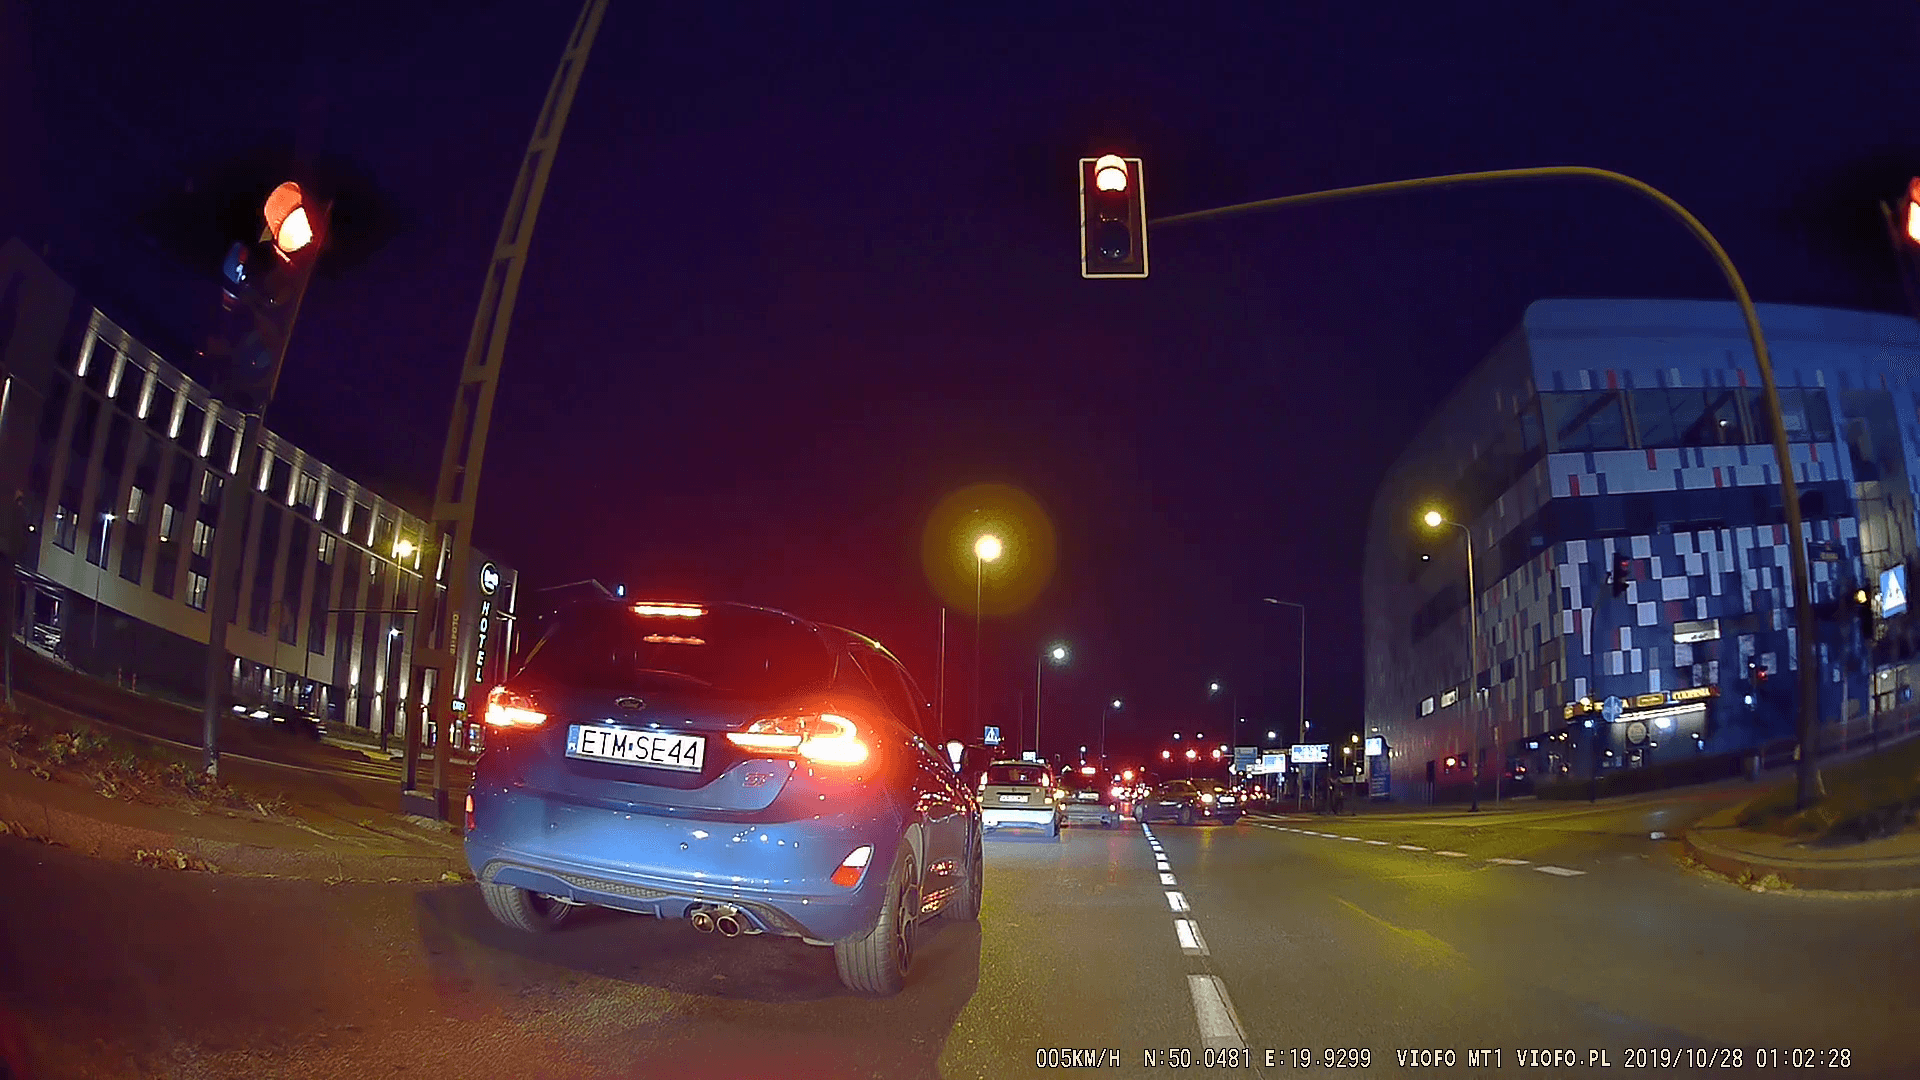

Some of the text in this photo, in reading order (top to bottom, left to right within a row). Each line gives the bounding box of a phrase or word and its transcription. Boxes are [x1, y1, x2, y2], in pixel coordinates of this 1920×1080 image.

[475, 600, 491, 683] HOTEL
[581, 729, 698, 766] ETM SE44
